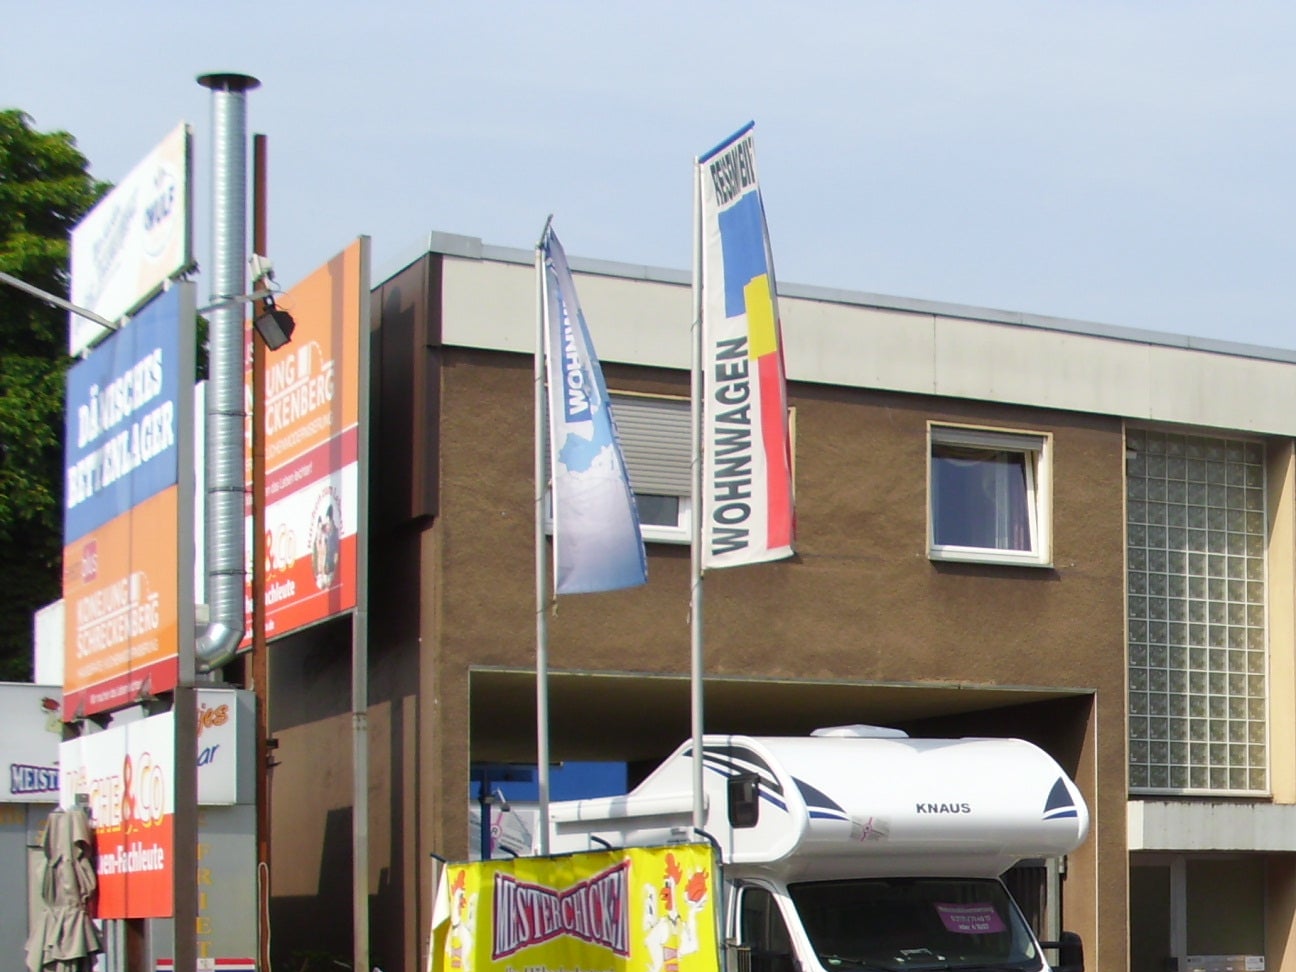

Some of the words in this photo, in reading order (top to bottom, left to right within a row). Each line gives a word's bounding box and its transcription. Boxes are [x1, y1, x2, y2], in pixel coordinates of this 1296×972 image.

[711, 336, 753, 556] WOHNWAGEN
[12, 765, 59, 793] MEIST
[916, 803, 971, 814] KNAUS
